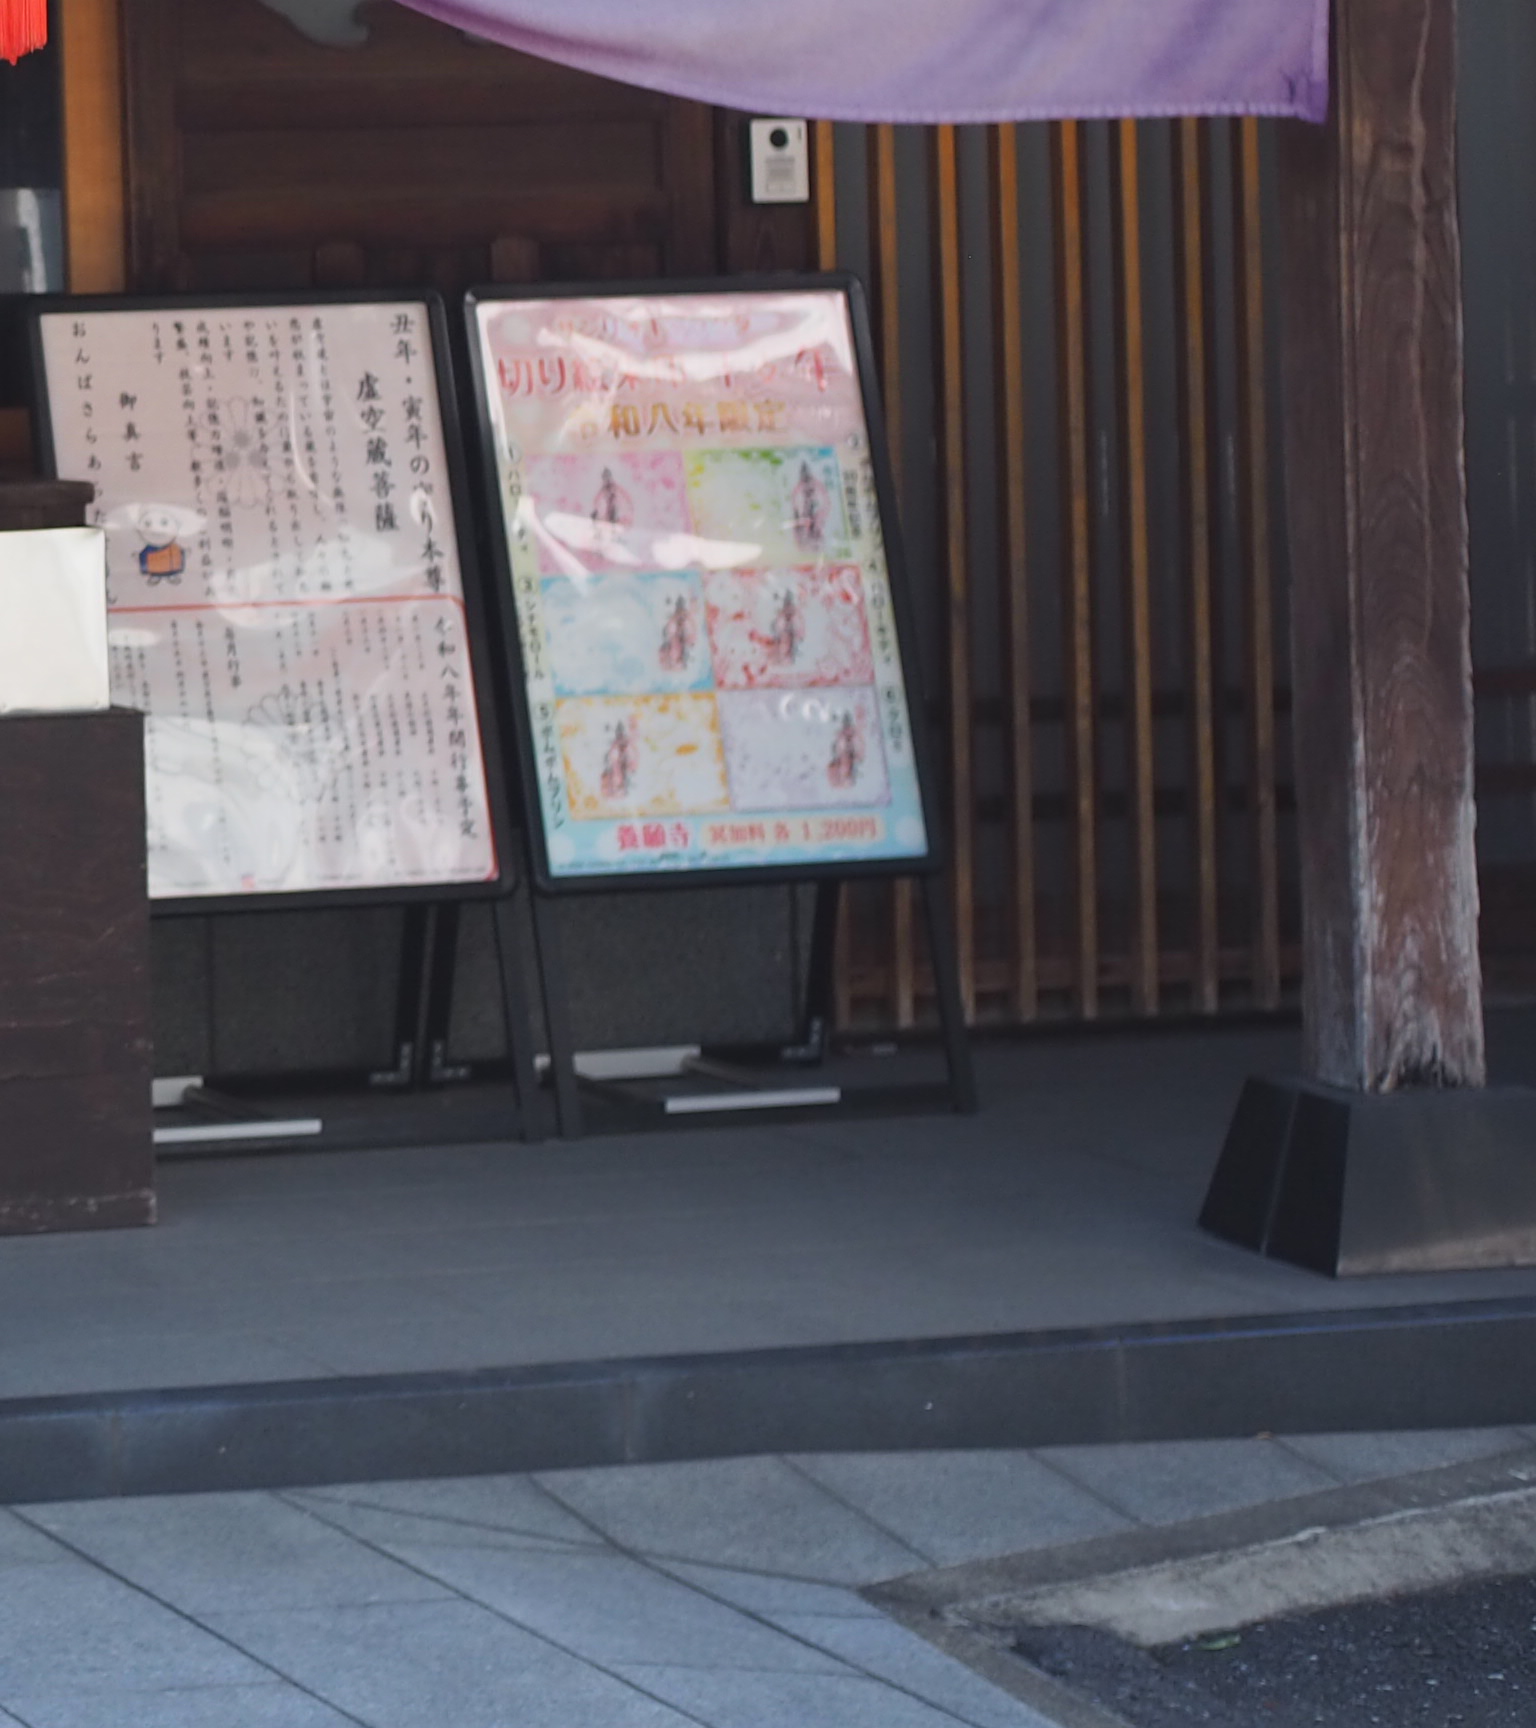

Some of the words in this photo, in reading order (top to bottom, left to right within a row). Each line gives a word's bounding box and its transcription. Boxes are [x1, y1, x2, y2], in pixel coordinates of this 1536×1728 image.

[218, 322, 235, 364] います
[117, 391, 146, 473] 御真言
